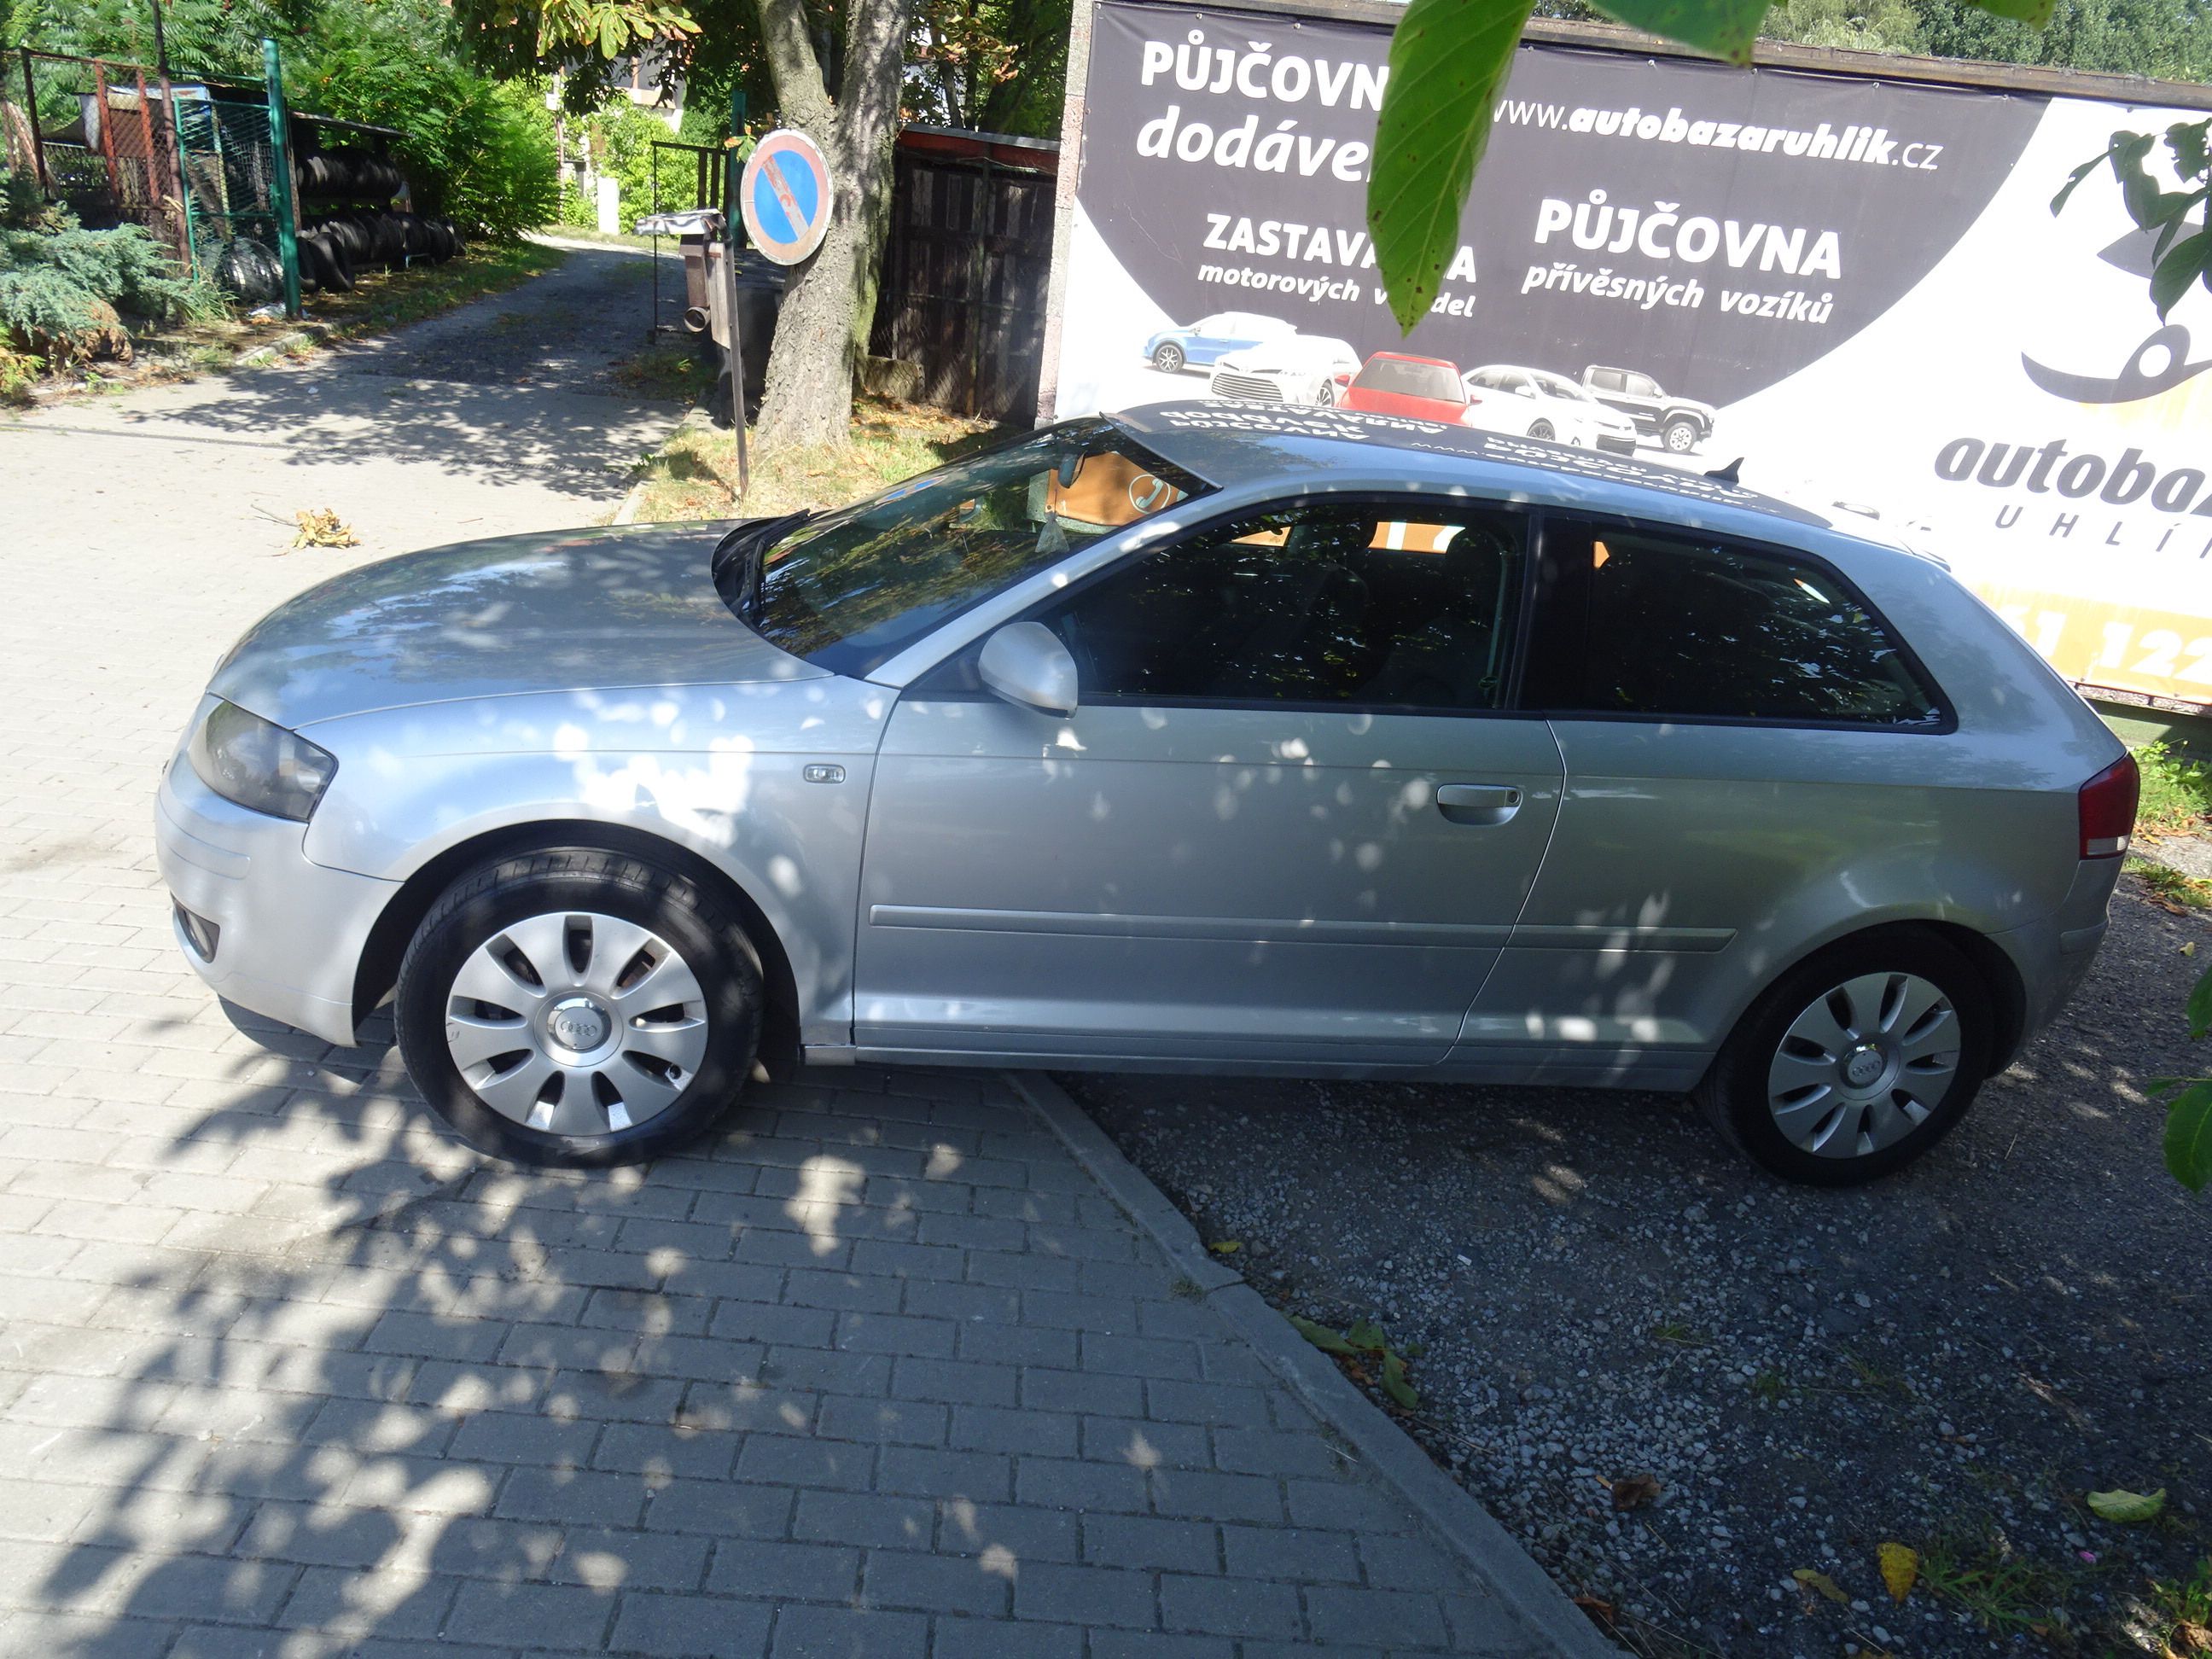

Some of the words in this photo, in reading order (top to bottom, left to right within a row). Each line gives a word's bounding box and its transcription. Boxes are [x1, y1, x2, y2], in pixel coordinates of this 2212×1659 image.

[1140, 29, 1389, 112] PŮJČOVN
[1137, 105, 1371, 183] dodáve
[1534, 189, 1842, 280] PŮJČOVNA
[1197, 263, 1360, 303] motorových
[1374, 287, 1476, 318] vdel
[1521, 261, 1704, 311] přívěsných
[1720, 287, 1835, 324] vozíků
[1995, 504, 2212, 560] UHLÍ
